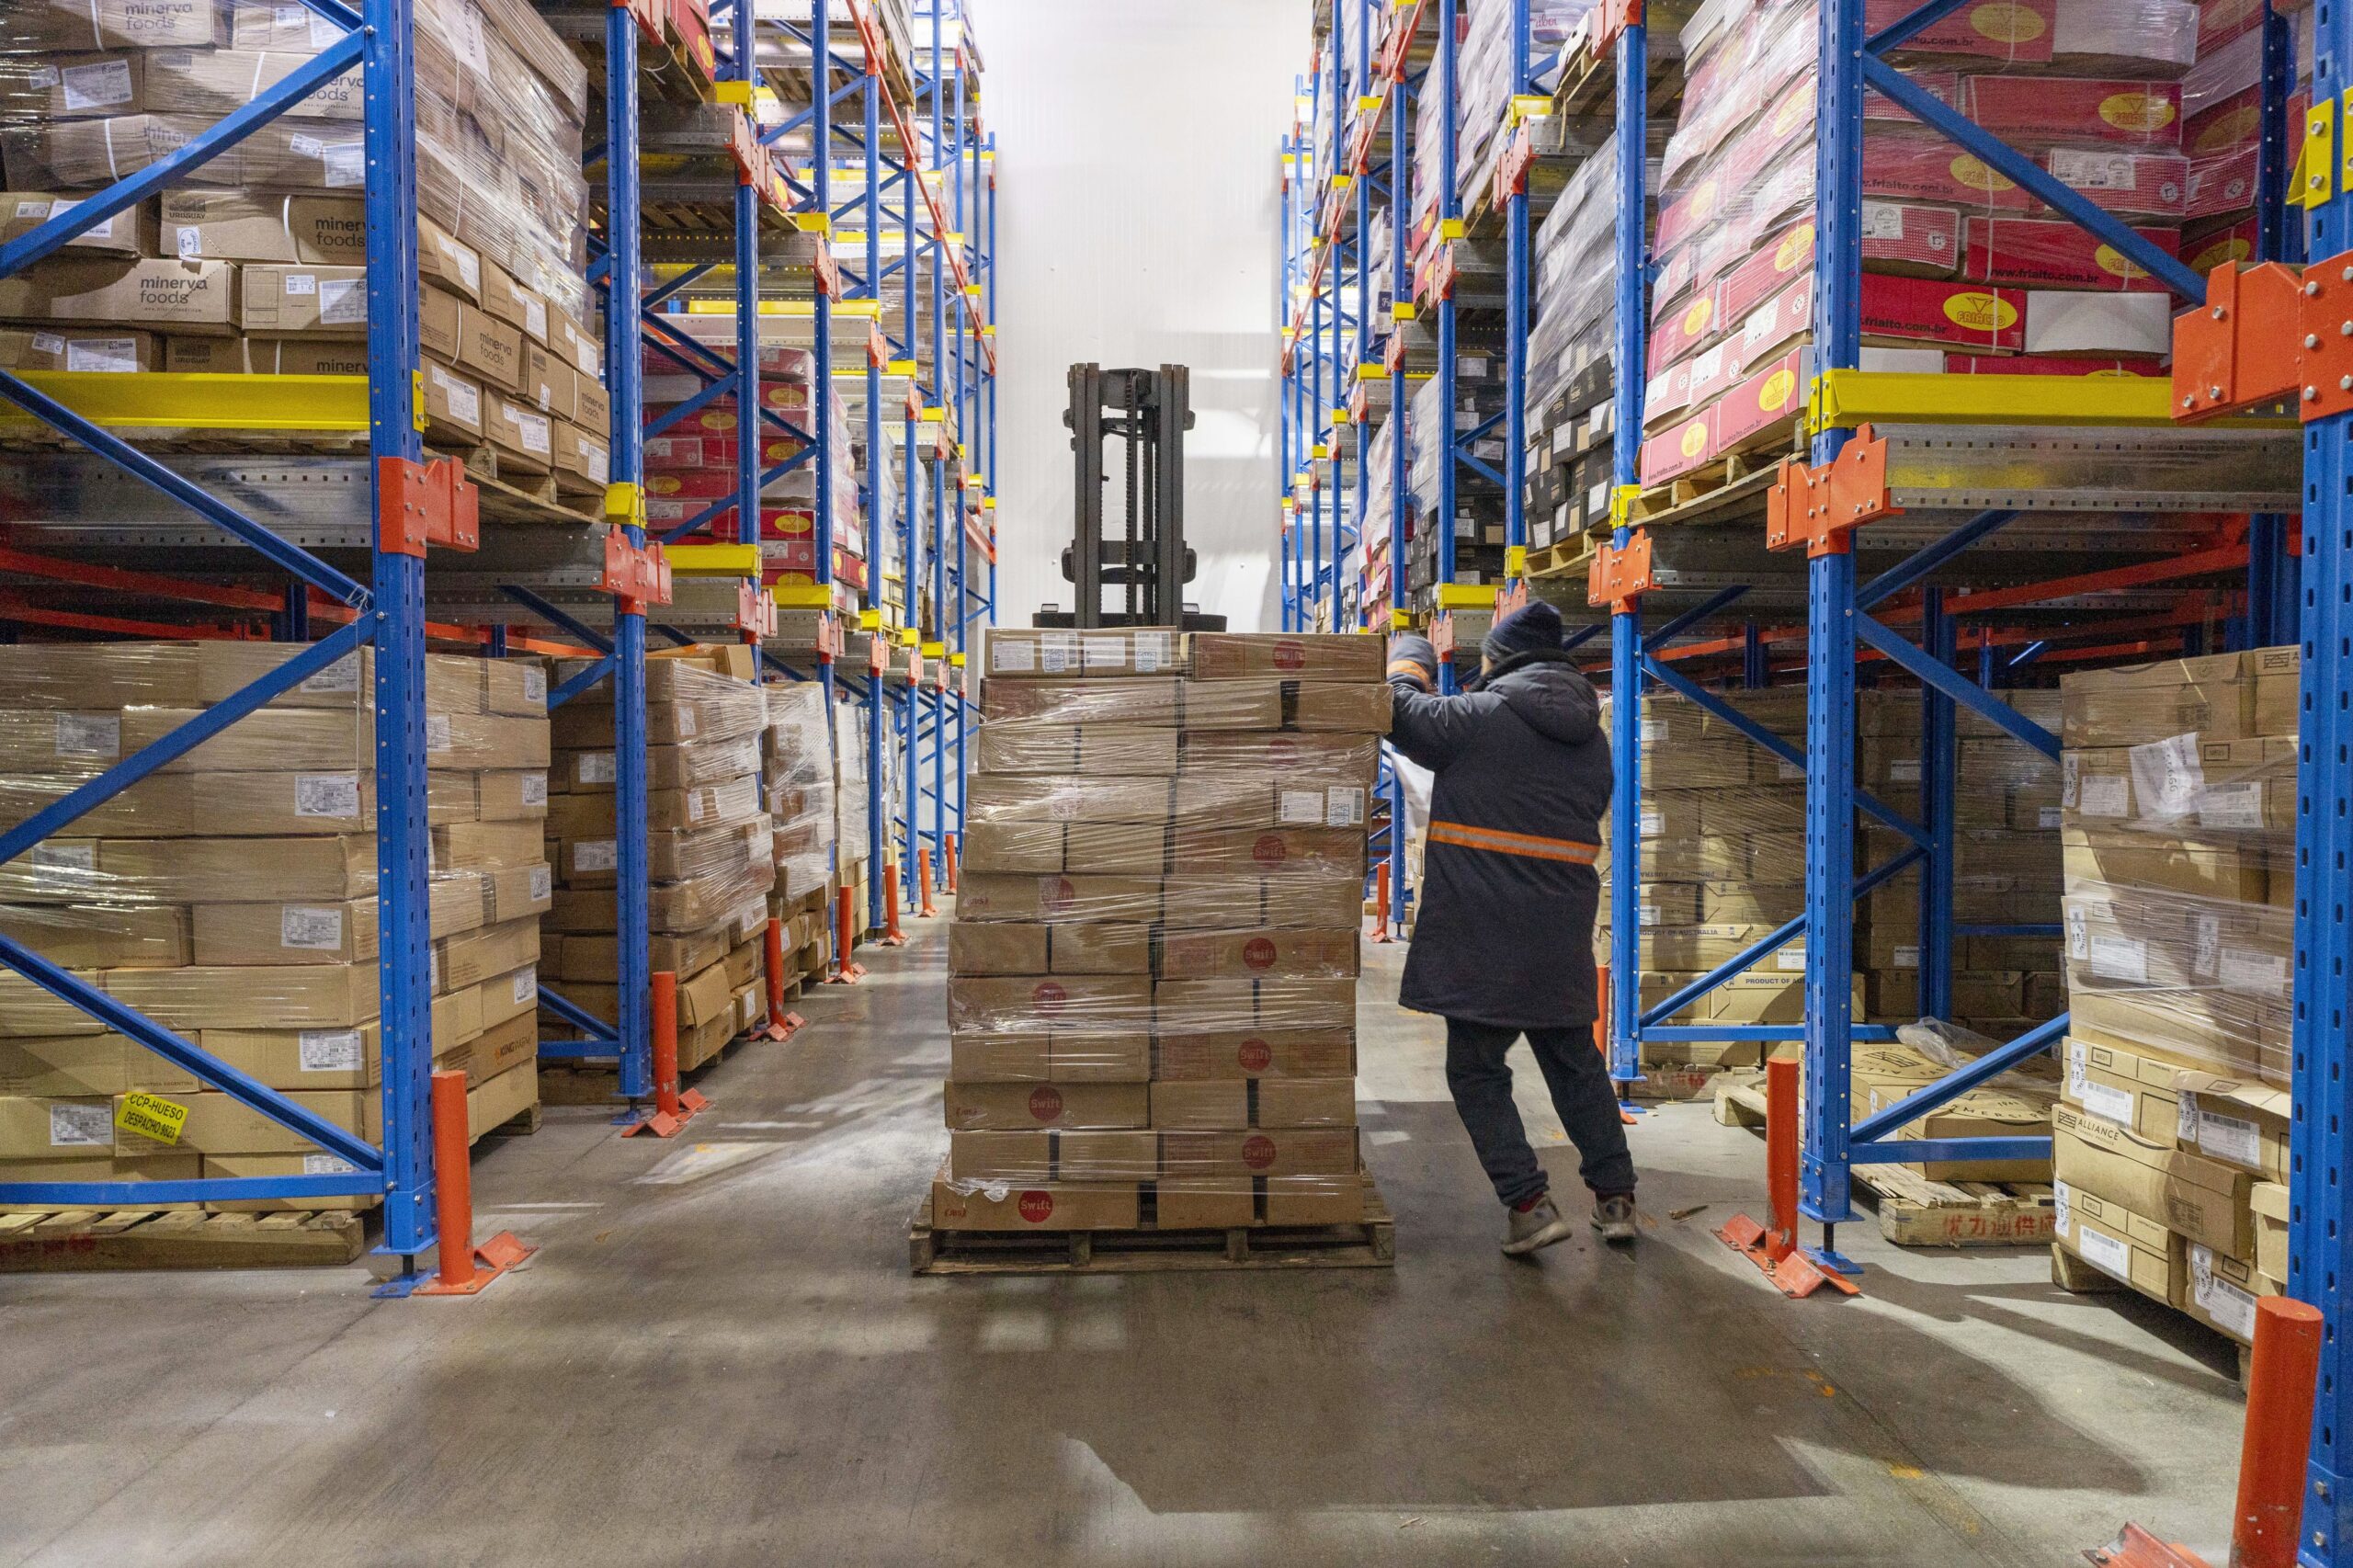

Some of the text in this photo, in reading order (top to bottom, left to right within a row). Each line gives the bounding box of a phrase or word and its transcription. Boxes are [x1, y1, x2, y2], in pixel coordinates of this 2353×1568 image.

[125, 2, 193, 16] minerva
[125, 17, 176, 30] foods
[306, 87, 348, 101] oods
[169, 211, 206, 220] URUGUAY
[315, 217, 367, 231] miner
[316, 233, 366, 247] foods
[140, 276, 208, 290] minerva
[140, 290, 189, 304] foods
[1861, 316, 1948, 334] .frialto.com.br
[1957, 311, 2006, 326] FRIALTO
[479, 332, 512, 357] minerva
[480, 344, 505, 366] foods
[1256, 846, 1285, 857] Swift
[1245, 949, 1275, 959] Swift
[1242, 1049, 1270, 1058] Swift
[130, 1094, 184, 1120] CCP-HUESO
[1031, 1098, 1061, 1108] Swift
[124, 1111, 161, 1133] DESPACHO
[2077, 1119, 2120, 1142] ALLIANCE
[1244, 1149, 1273, 1158] Swift
[1020, 1200, 1051, 1210] Swift
